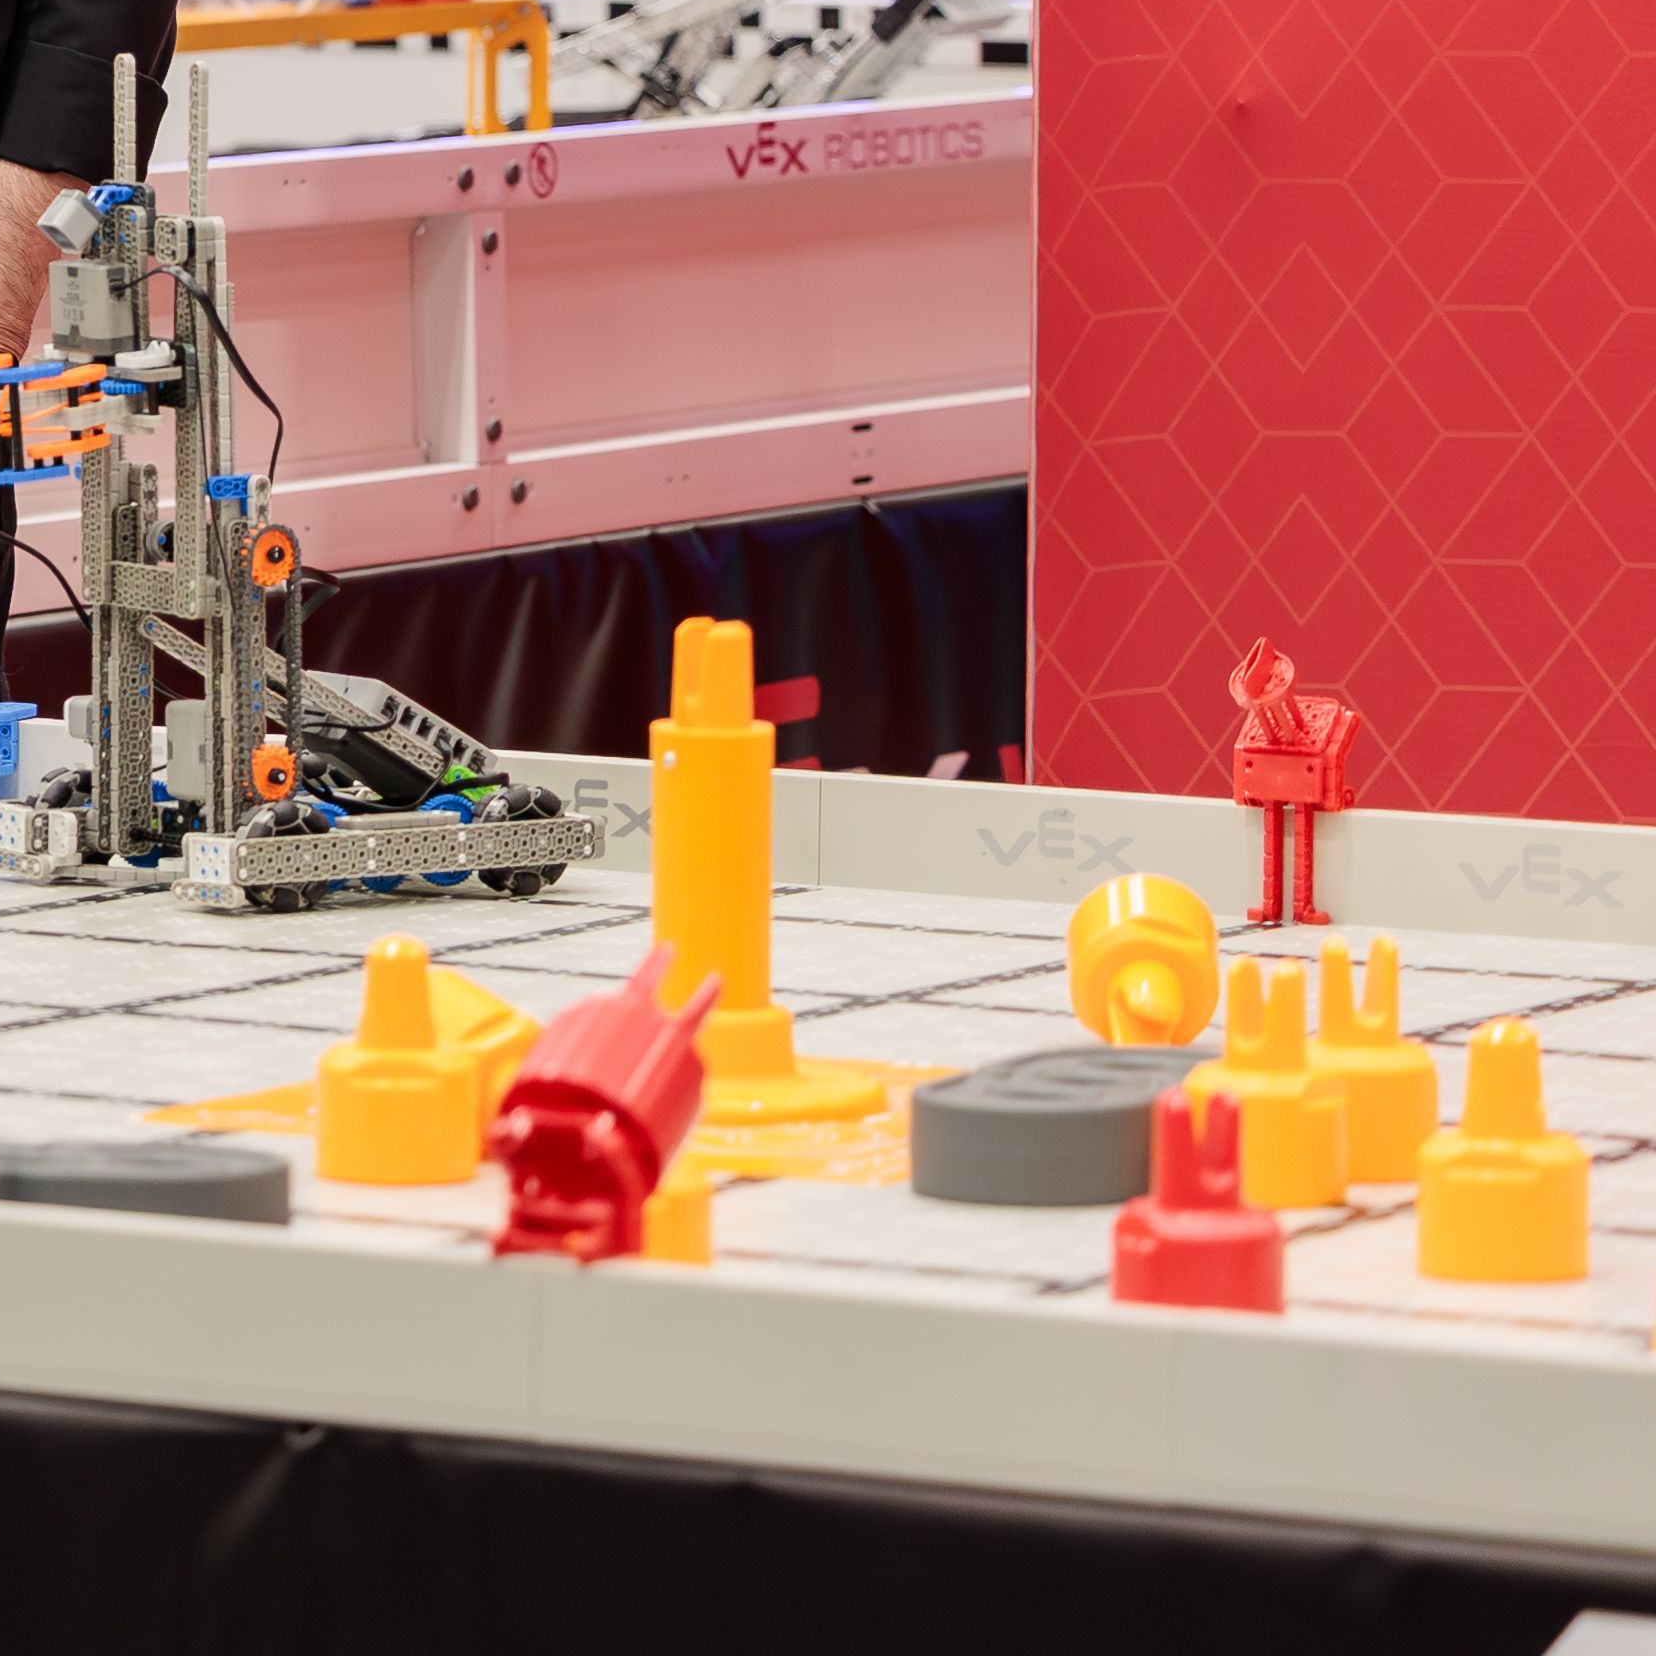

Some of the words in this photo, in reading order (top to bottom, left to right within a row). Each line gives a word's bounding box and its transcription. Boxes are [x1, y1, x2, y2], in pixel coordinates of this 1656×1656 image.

[725, 121, 810, 180] VEX
[823, 121, 985, 172] ROBOTICS
[975, 808, 1136, 874] VEX
[1457, 843, 1624, 910] VEX
